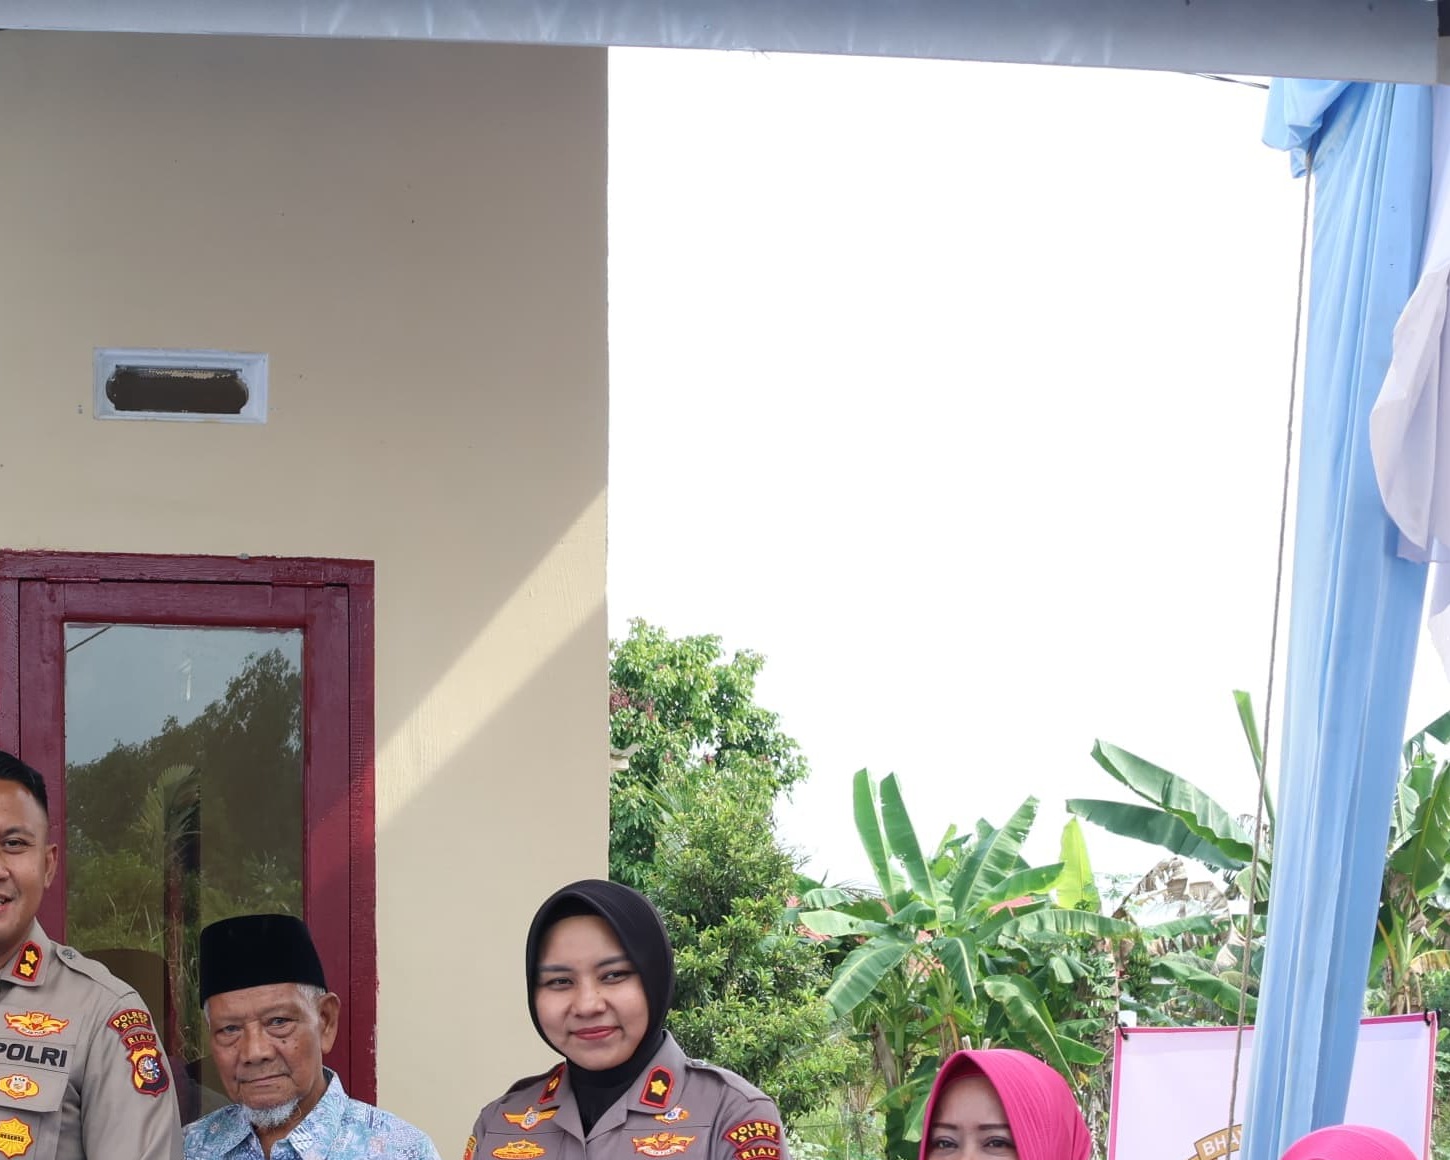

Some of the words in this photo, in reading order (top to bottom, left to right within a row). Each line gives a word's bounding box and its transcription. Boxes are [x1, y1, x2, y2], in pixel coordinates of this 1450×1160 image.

[113, 1011, 148, 1028] POLRES
[127, 1034, 153, 1045] RIAU
[730, 1122, 776, 1140] POLRES
[741, 1147, 776, 1159] RIAU
